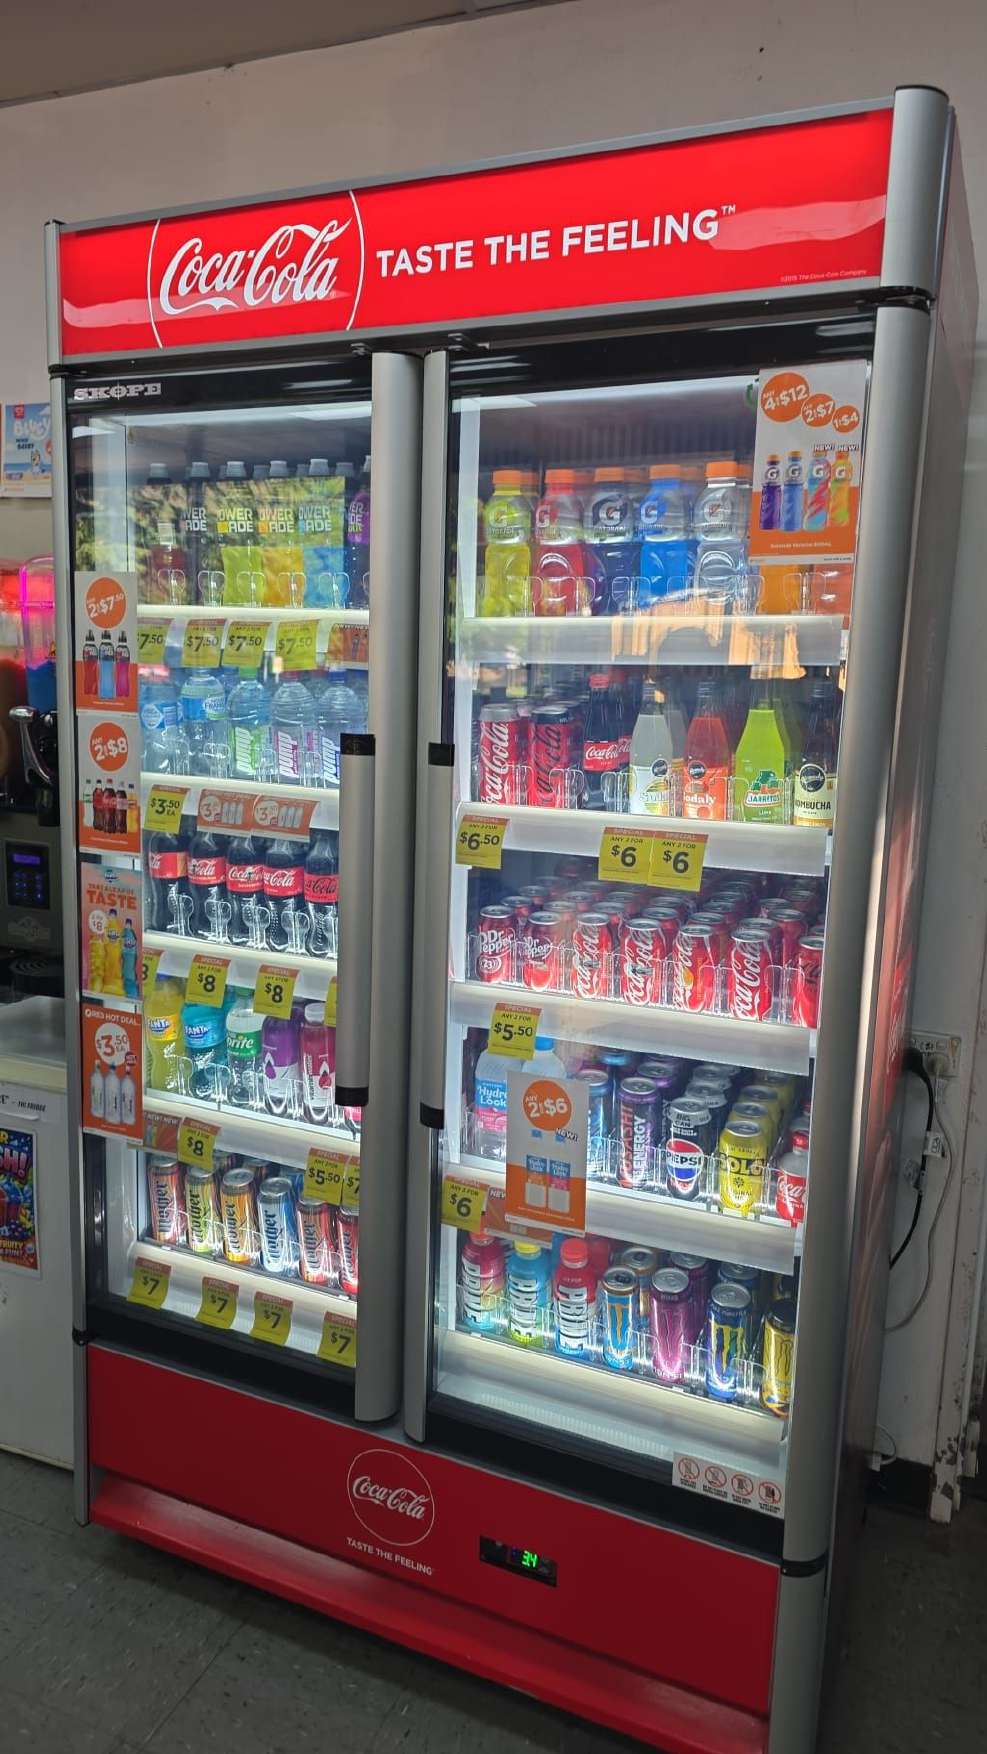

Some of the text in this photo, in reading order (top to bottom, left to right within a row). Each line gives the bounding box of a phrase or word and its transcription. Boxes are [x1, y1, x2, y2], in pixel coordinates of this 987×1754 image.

[377, 240, 473, 278] TASTE
[485, 229, 551, 267] THE
[160, 216, 353, 317] Coca-Cola
[186, 636, 219, 652] $7.50
[228, 636, 262, 652] $7.50
[278, 636, 312, 655] $7.50
[106, 737, 128, 759] $8
[151, 798, 180, 816] $3.50
[459, 832, 500, 851] $6.50
[611, 844, 637, 868] $6
[662, 849, 690, 874] $6
[87, 890, 137, 911] TASTE
[197, 973, 216, 993] $8
[265, 983, 283, 1004] $8
[105, 1013, 119, 1022] HOT
[493, 1022, 533, 1042] $5.50
[529, 1097, 568, 1118] 2 $6
[186, 1136, 204, 1158] $8
[667, 1151, 702, 1166] PEPSI
[308, 1167, 341, 1186] $5.50
[449, 1192, 472, 1218] $6
[143, 1275, 160, 1296] $7
[210, 1295, 228, 1314] $7
[263, 1310, 281, 1330] $7
[330, 1332, 352, 1354] $7
[353, 1476, 430, 1520] Coca-Cola
[347, 1536, 433, 1577] TASTE THE FEELING
